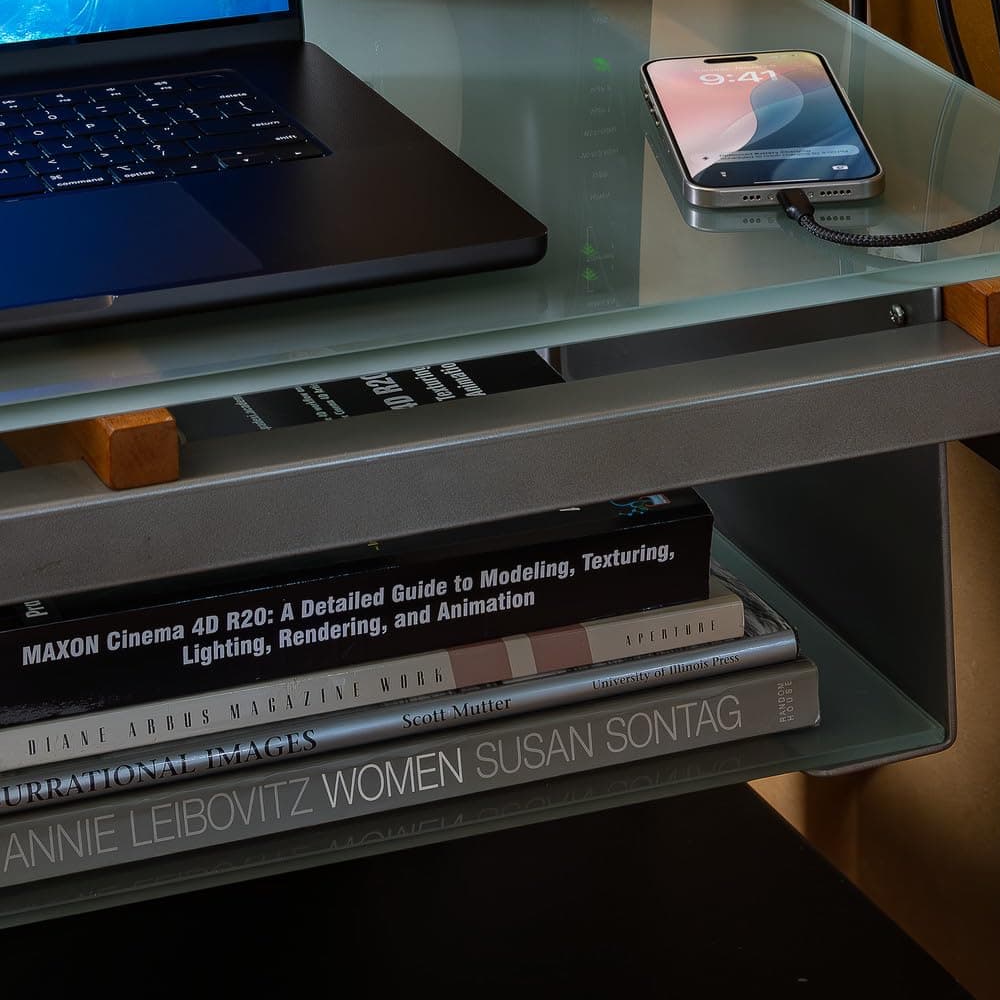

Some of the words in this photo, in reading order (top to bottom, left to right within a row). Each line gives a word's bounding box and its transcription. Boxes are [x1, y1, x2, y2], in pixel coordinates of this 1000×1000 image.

[699, 69, 779, 86] 9:41
[57, 177, 104, 187] command
[124, 170, 155, 178] option
[22, 634, 99, 666] MAXON
[106, 622, 185, 652] Cinema
[191, 615, 219, 636] 4D
[227, 606, 274, 631] R20:
[280, 602, 295, 623] A
[302, 586, 385, 619] Detailed
[392, 574, 448, 603] Guide
[454, 574, 473, 594] to
[480, 557, 576, 588] Modeling,
[582, 542, 675, 573] Texturing,
[182, 636, 272, 667] Lighting,
[279, 617, 388, 650] Rendering,
[394, 605, 431, 629] and
[437, 588, 535, 622] Animation
[625, 618, 718, 648] APERTURE
[592, 670, 650, 692] University
[654, 665, 667, 679] of
[670, 658, 709, 676] Illinois
[712, 653, 740, 669] Press
[27, 726, 107, 756] DIANE
[128, 708, 210, 740] ARBUS
[229, 682, 361, 722] MAGAZINE
[380, 669, 443, 694] WORK
[402, 707, 447, 729] Scott
[452, 696, 512, 722] Mutter
[784, 680, 794, 721] HOUSE
[2, 752, 198, 807] URRATIONAL
[206, 728, 318, 769] IMAGES
[3, 810, 118, 873] ANNIE
[130, 778, 314, 848] LEIBOVITZ
[321, 747, 464, 809] WOMEN
[476, 721, 594, 779] SUSAN
[605, 695, 742, 753] SONTAG
